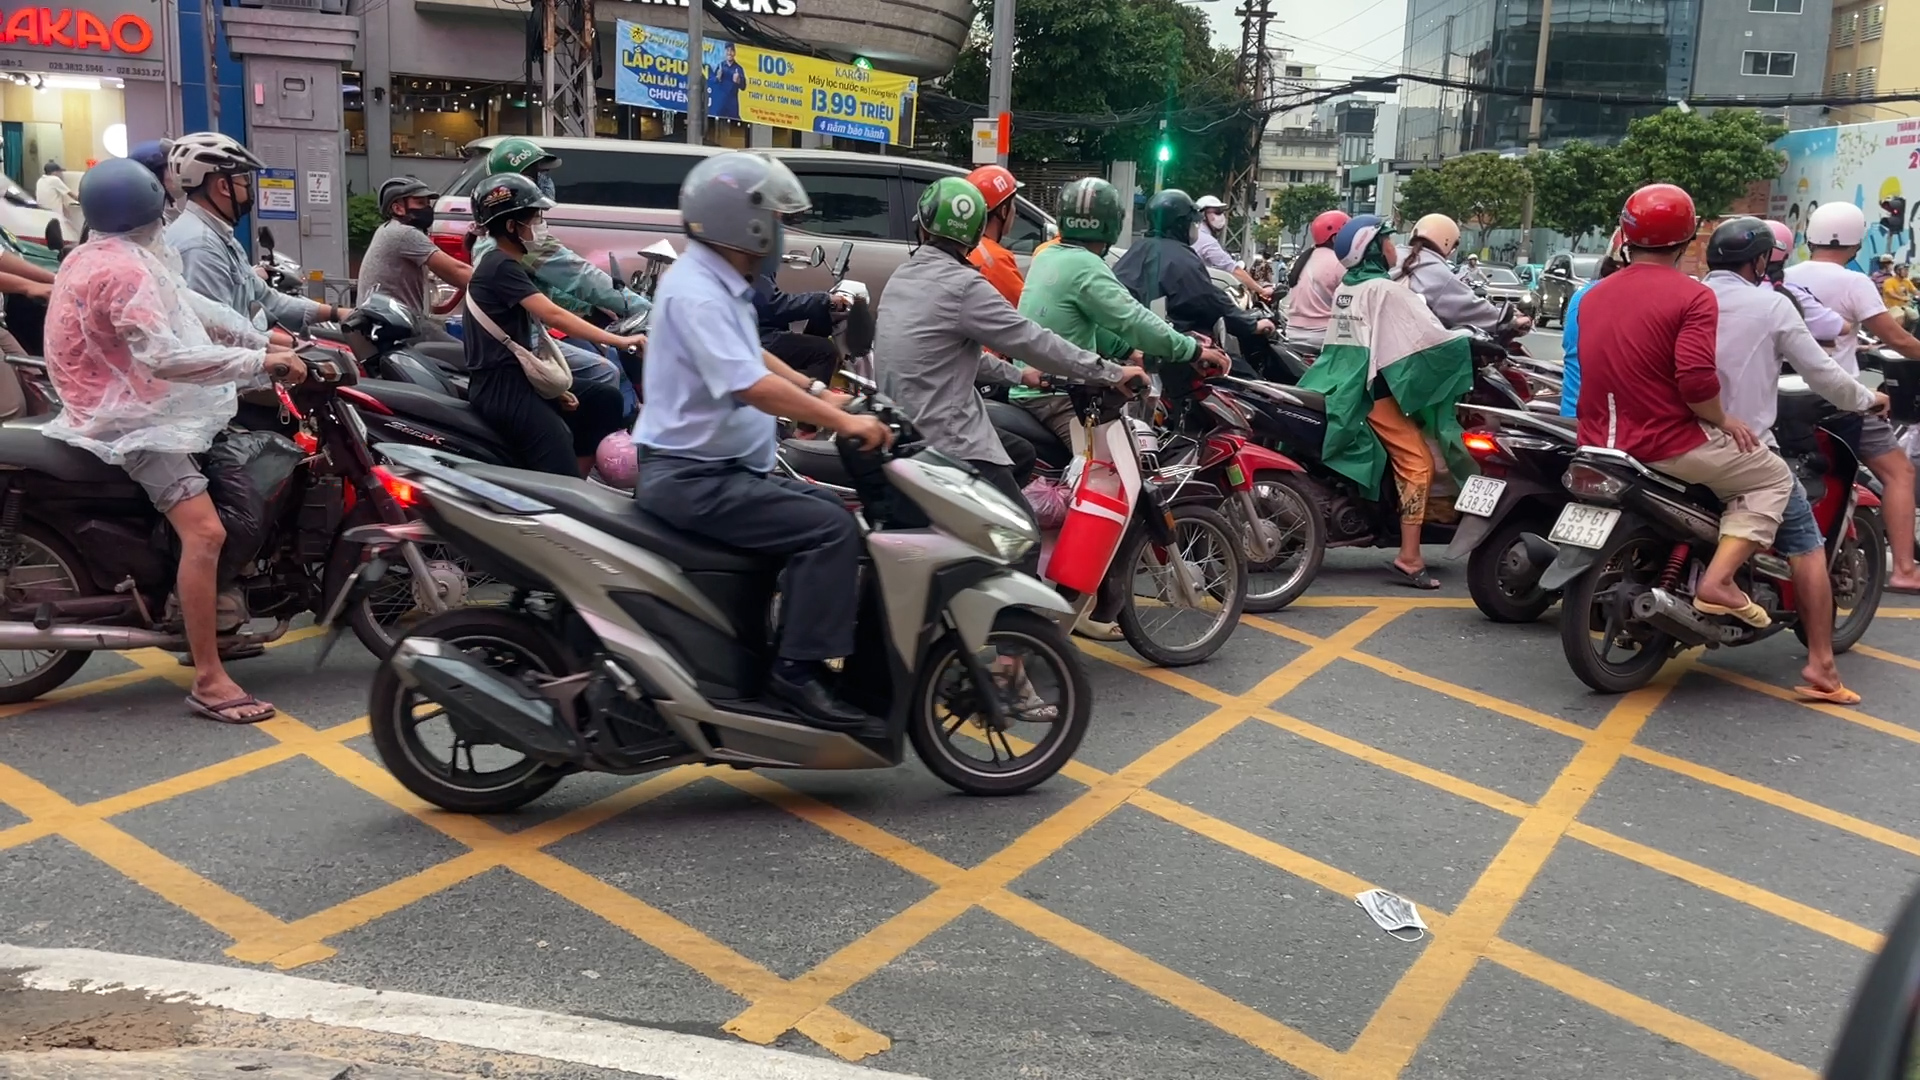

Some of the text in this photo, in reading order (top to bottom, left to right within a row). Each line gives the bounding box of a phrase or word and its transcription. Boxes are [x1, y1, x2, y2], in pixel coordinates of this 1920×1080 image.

[0, 7, 153, 54] AKAO
[623, 46, 709, 80] LẮP CHUN
[758, 54, 795, 76] 100%
[639, 71, 677, 87] XÀI LÂU
[808, 74, 826, 87] Máy
[826, 77, 838, 89] lọc
[839, 81, 859, 93] nước
[860, 100, 894, 124] TRIỆU
[820, 120, 826, 130] 4
[826, 121, 846, 134] năm
[864, 125, 885, 140] hành
[510, 149, 532, 166] Grab
[947, 218, 969, 230] gojek
[1066, 216, 1100, 229] Grab
